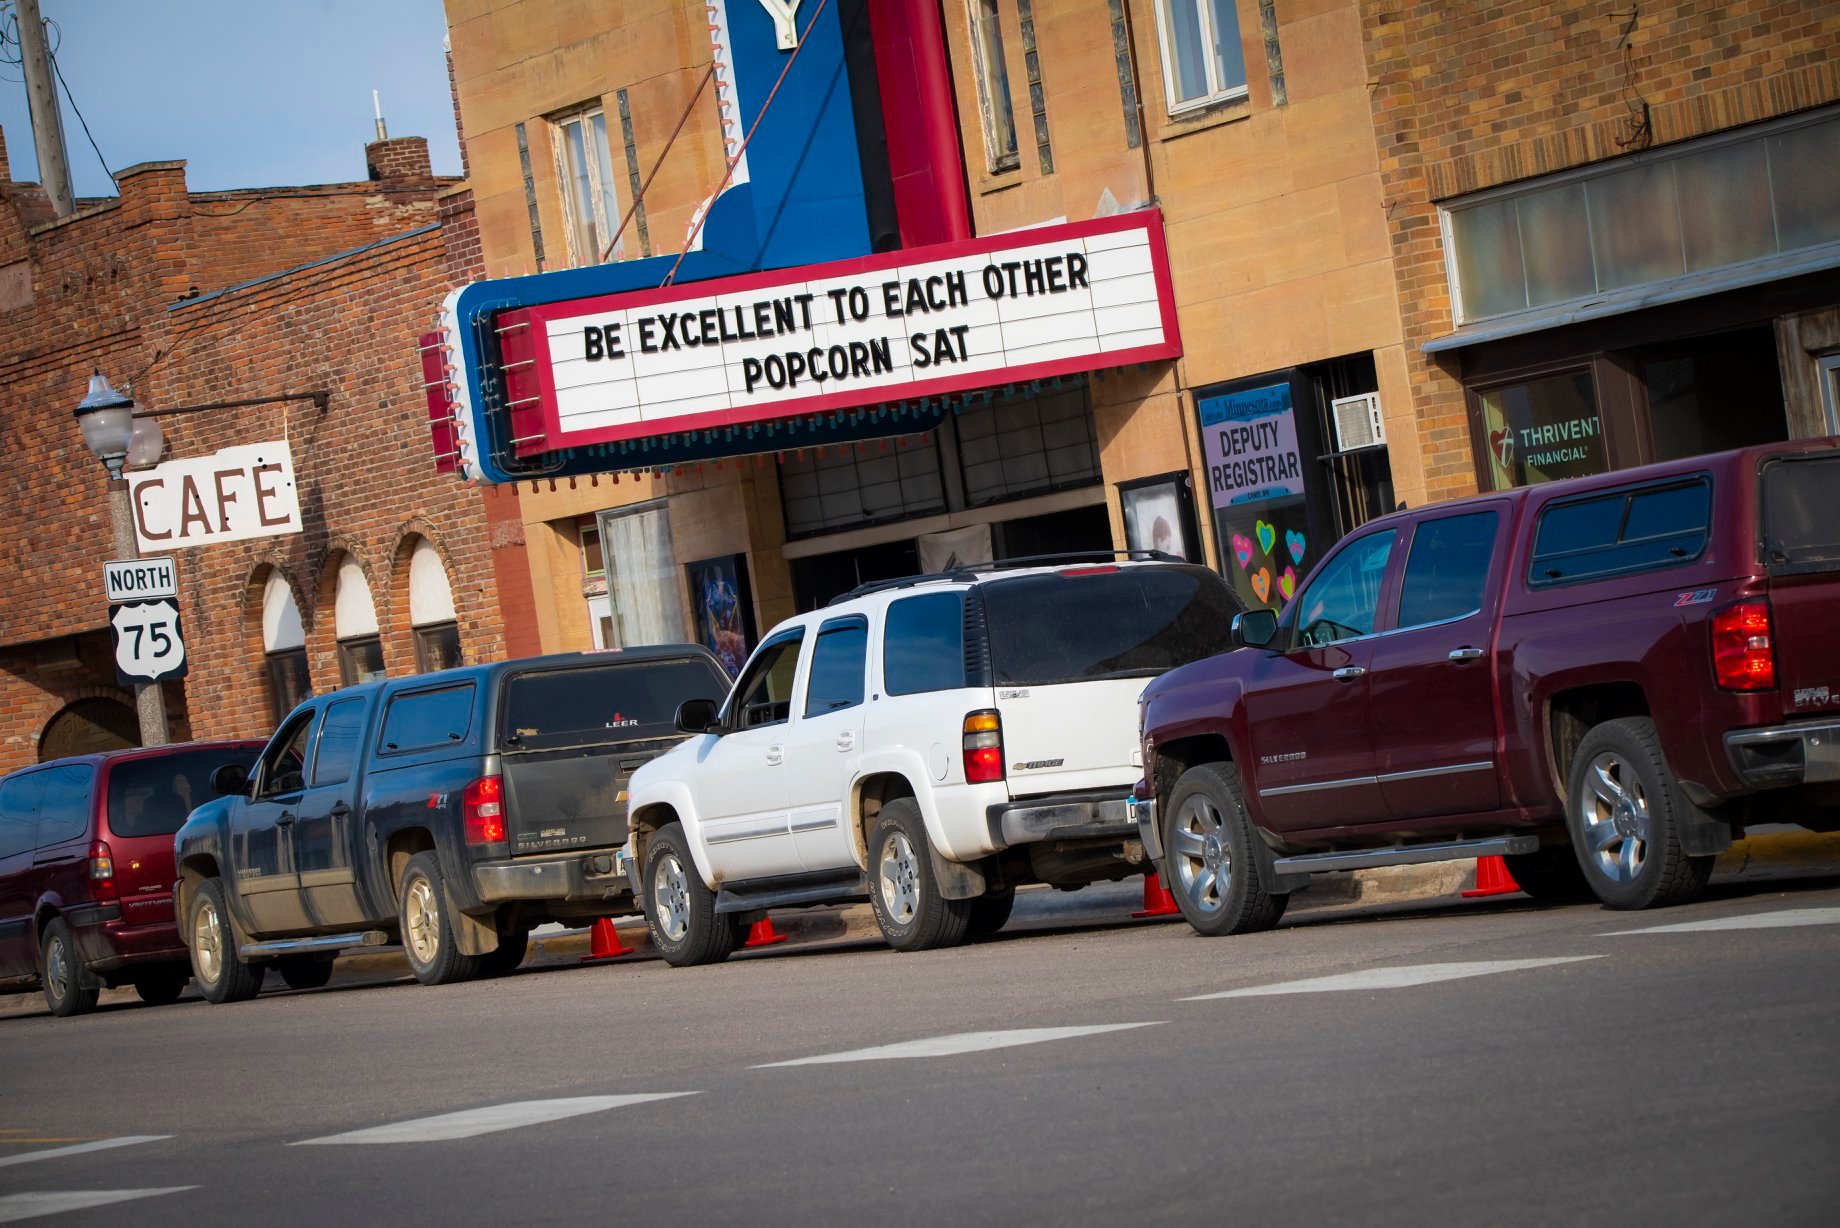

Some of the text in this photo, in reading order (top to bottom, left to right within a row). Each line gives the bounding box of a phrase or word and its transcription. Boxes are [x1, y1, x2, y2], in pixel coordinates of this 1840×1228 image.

[584, 252, 1089, 361] BE EXCELLENT TO EACH OTHER
[743, 324, 969, 394] POPCORN SAT
[1219, 420, 1278, 458] DEPUTY
[1519, 416, 1600, 448] THRIVENT
[1211, 451, 1300, 493] REGISTRAR
[1527, 446, 1588, 467] FINANCIAL
[133, 462, 291, 541] CAFE
[109, 566, 171, 592] NORTH
[1673, 588, 1718, 607] Z71
[123, 621, 172, 661] 75
[605, 719, 639, 728] LEER
[1260, 751, 1306, 764] SILVERADO
[518, 836, 586, 849] SILVERADO
